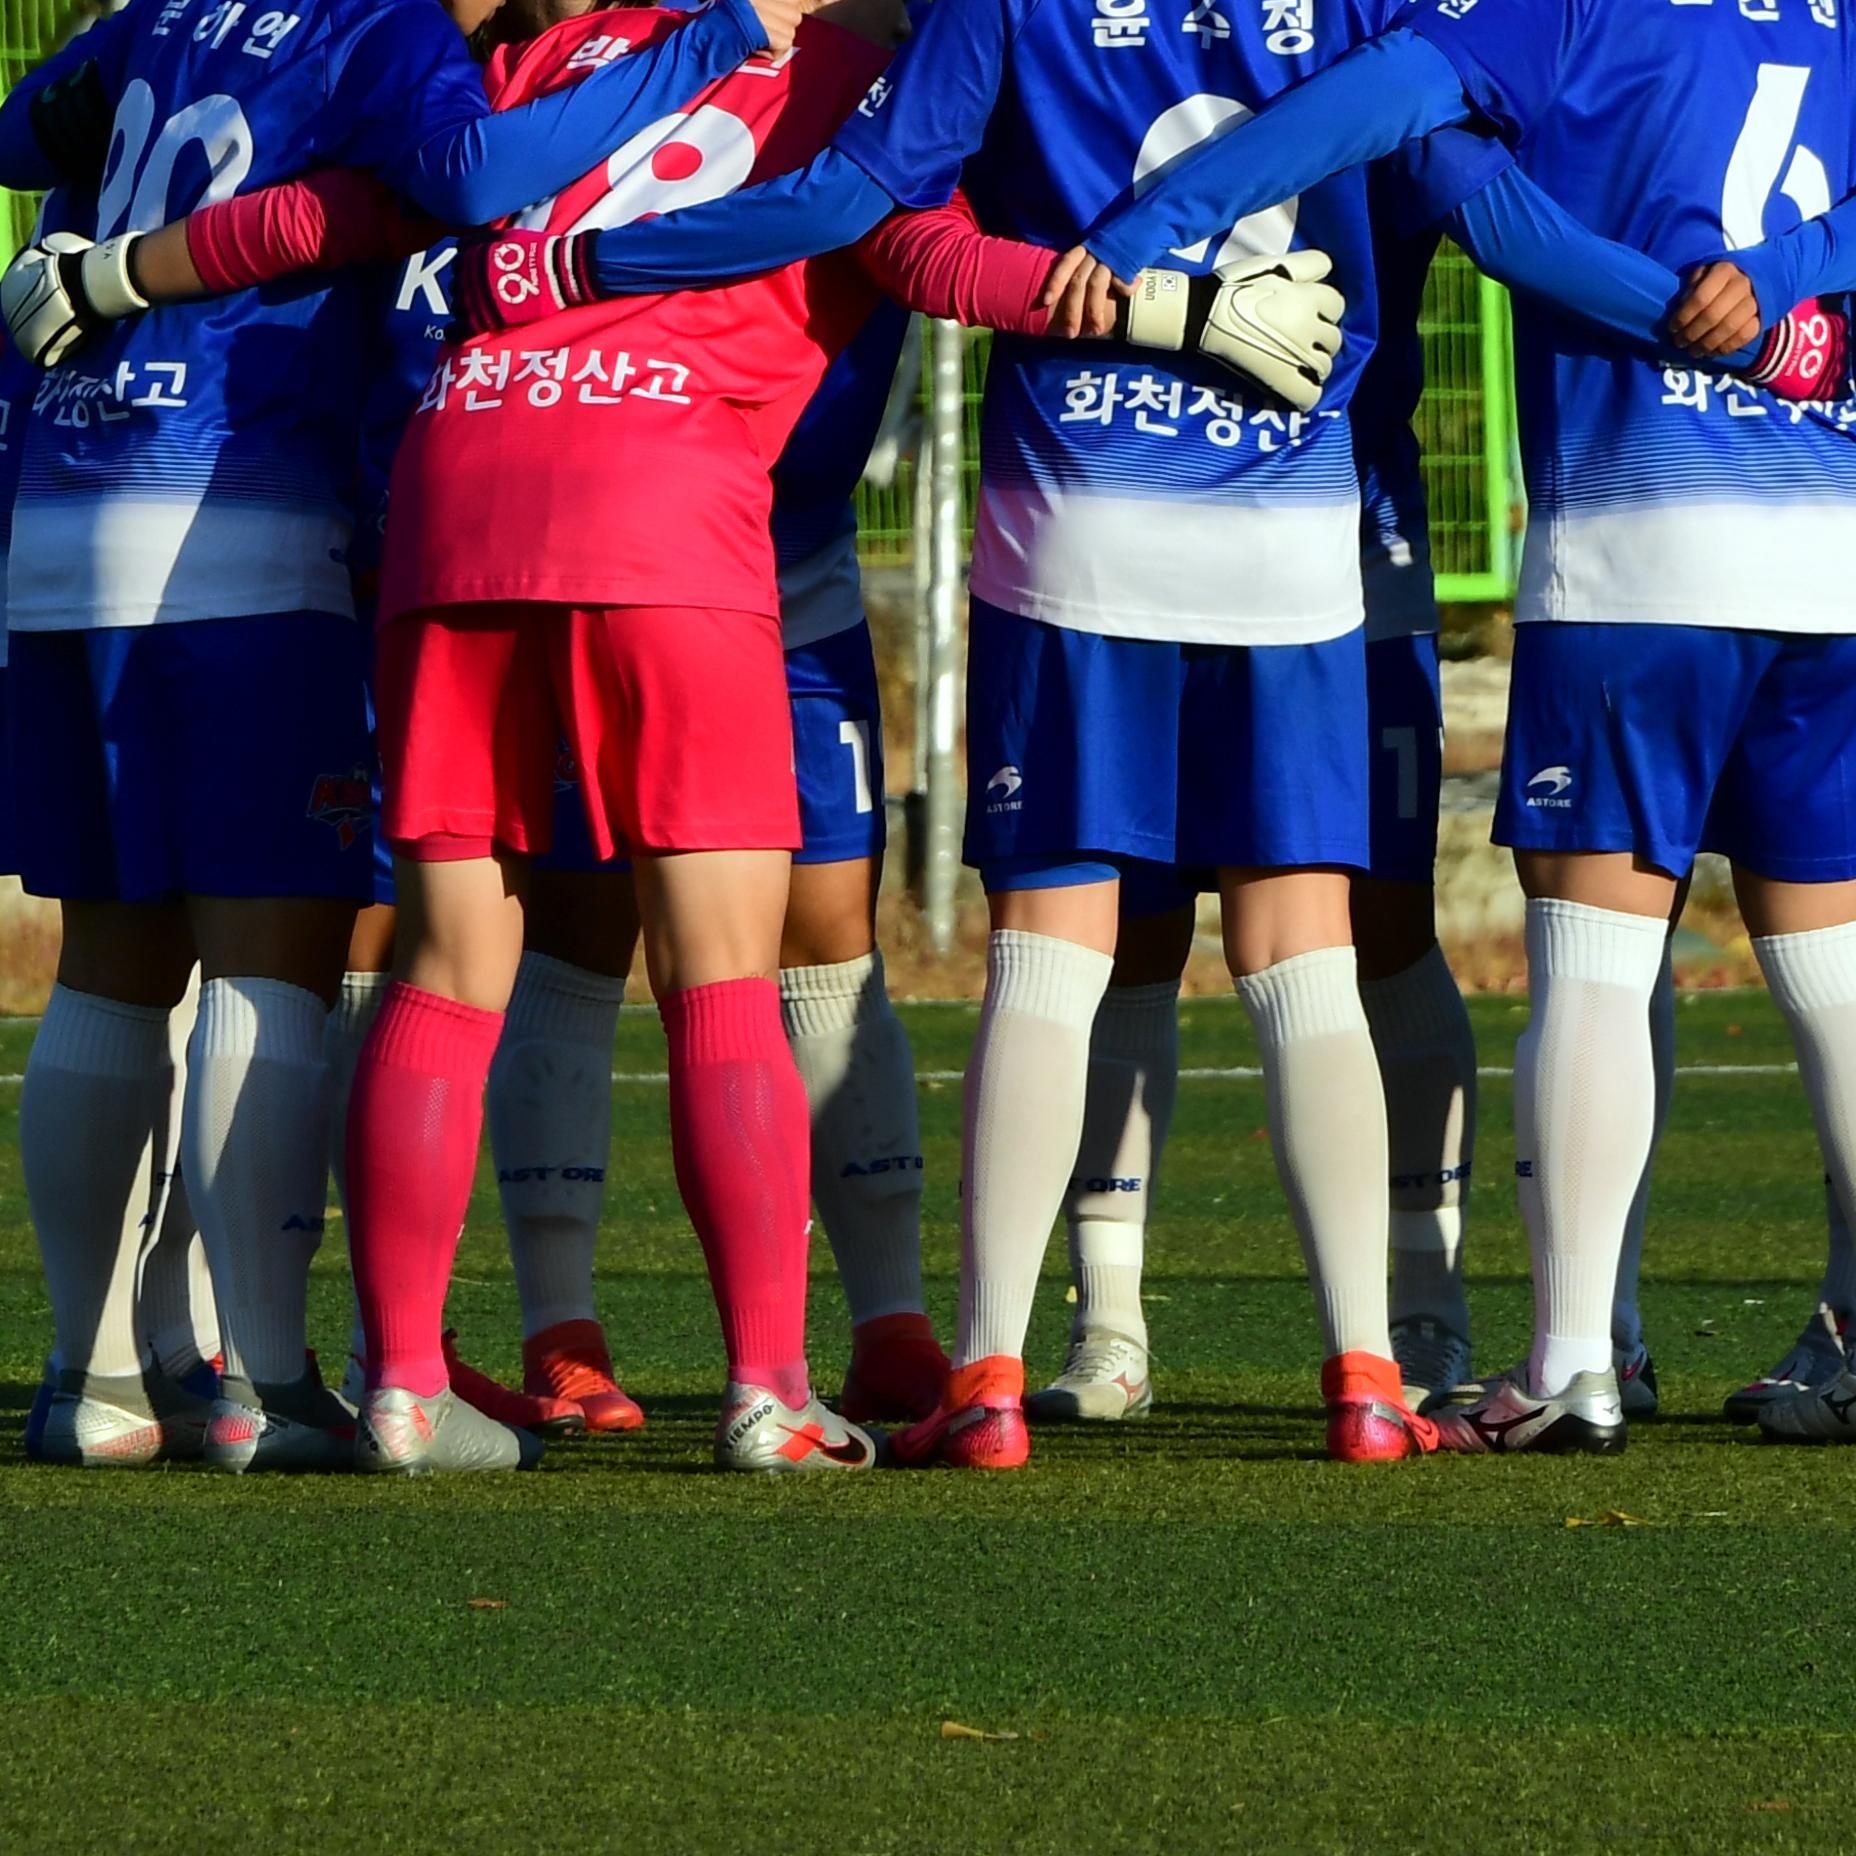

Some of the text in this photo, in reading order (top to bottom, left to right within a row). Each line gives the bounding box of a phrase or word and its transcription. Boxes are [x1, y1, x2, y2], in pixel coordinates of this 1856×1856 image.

[1721, 63, 1831, 252] 6
[1059, 370, 1342, 453] 화천정산
[1526, 796, 1572, 808] ASTORE
